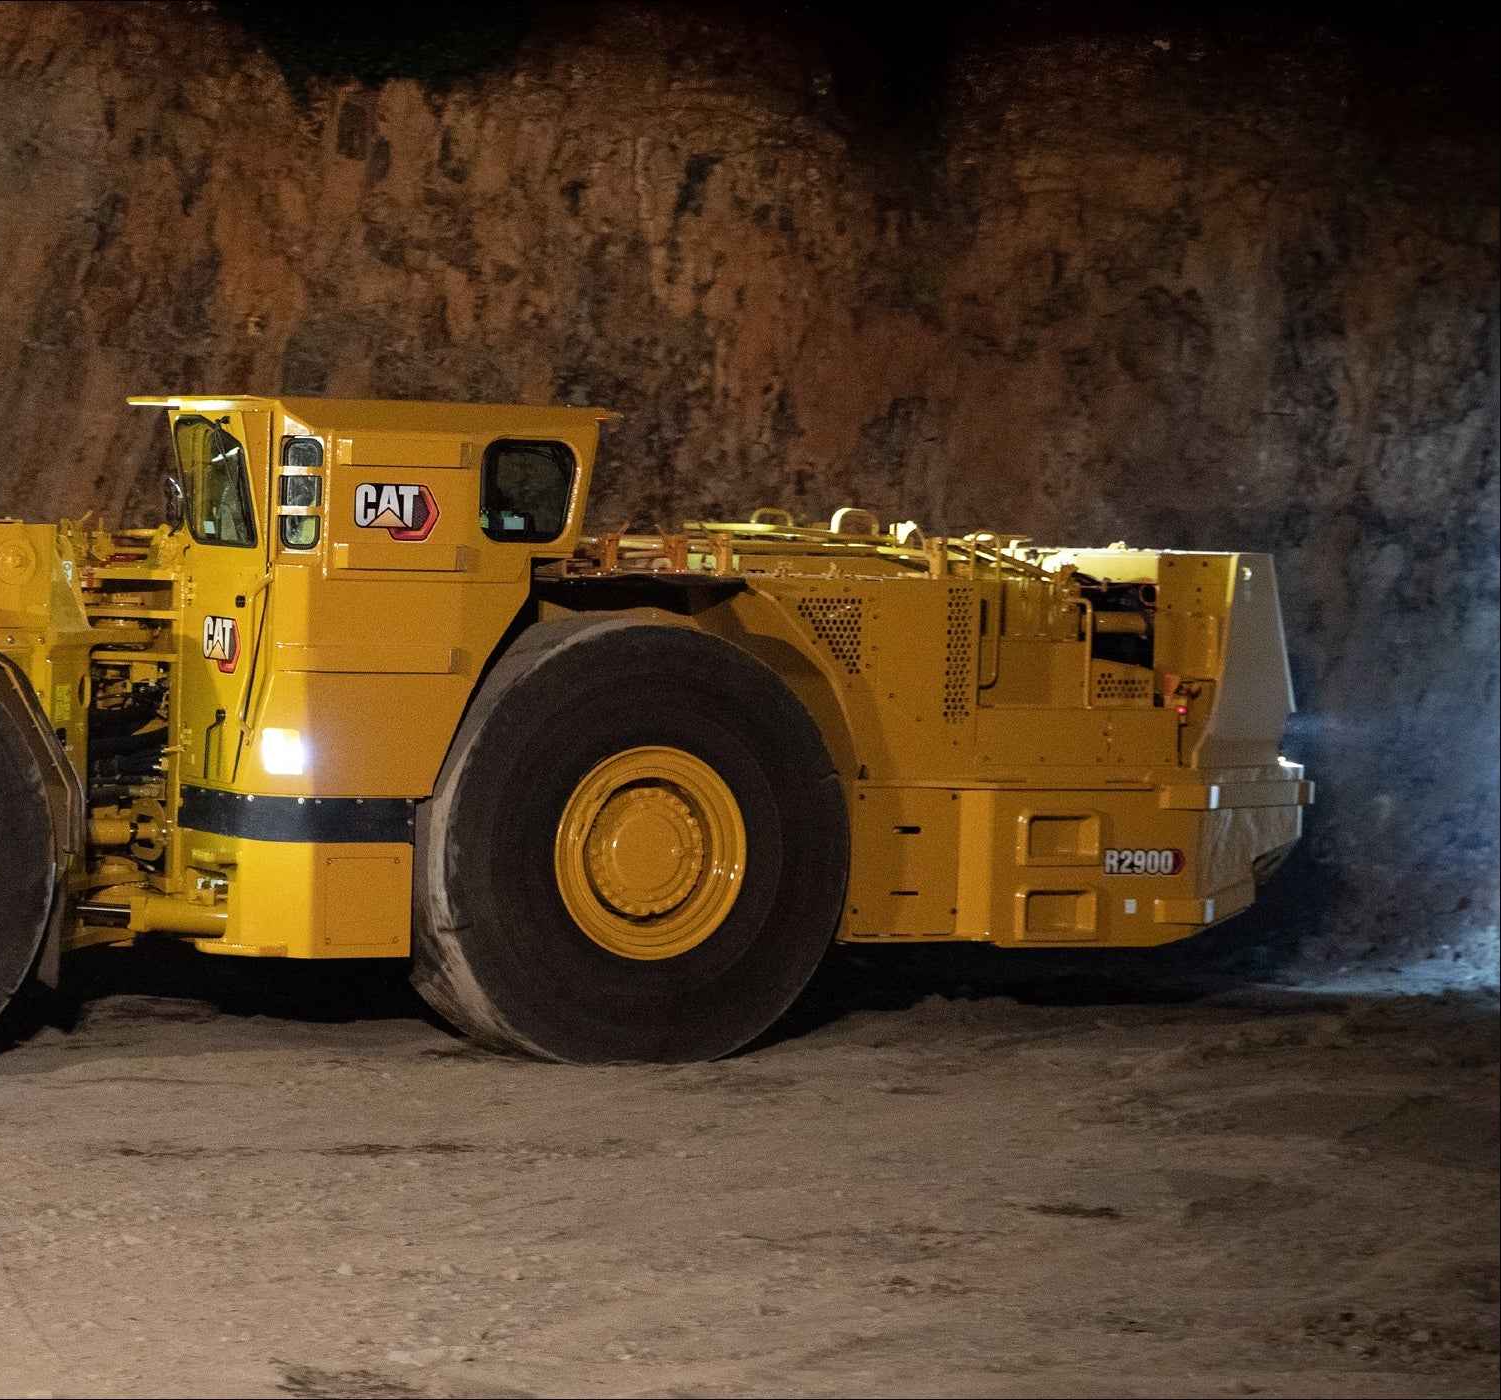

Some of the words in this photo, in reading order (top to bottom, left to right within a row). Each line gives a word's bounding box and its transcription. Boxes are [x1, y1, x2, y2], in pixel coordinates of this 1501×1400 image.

[356, 483, 419, 528] CAT
[203, 616, 233, 660] CAT
[1104, 849, 1174, 875] R2900
